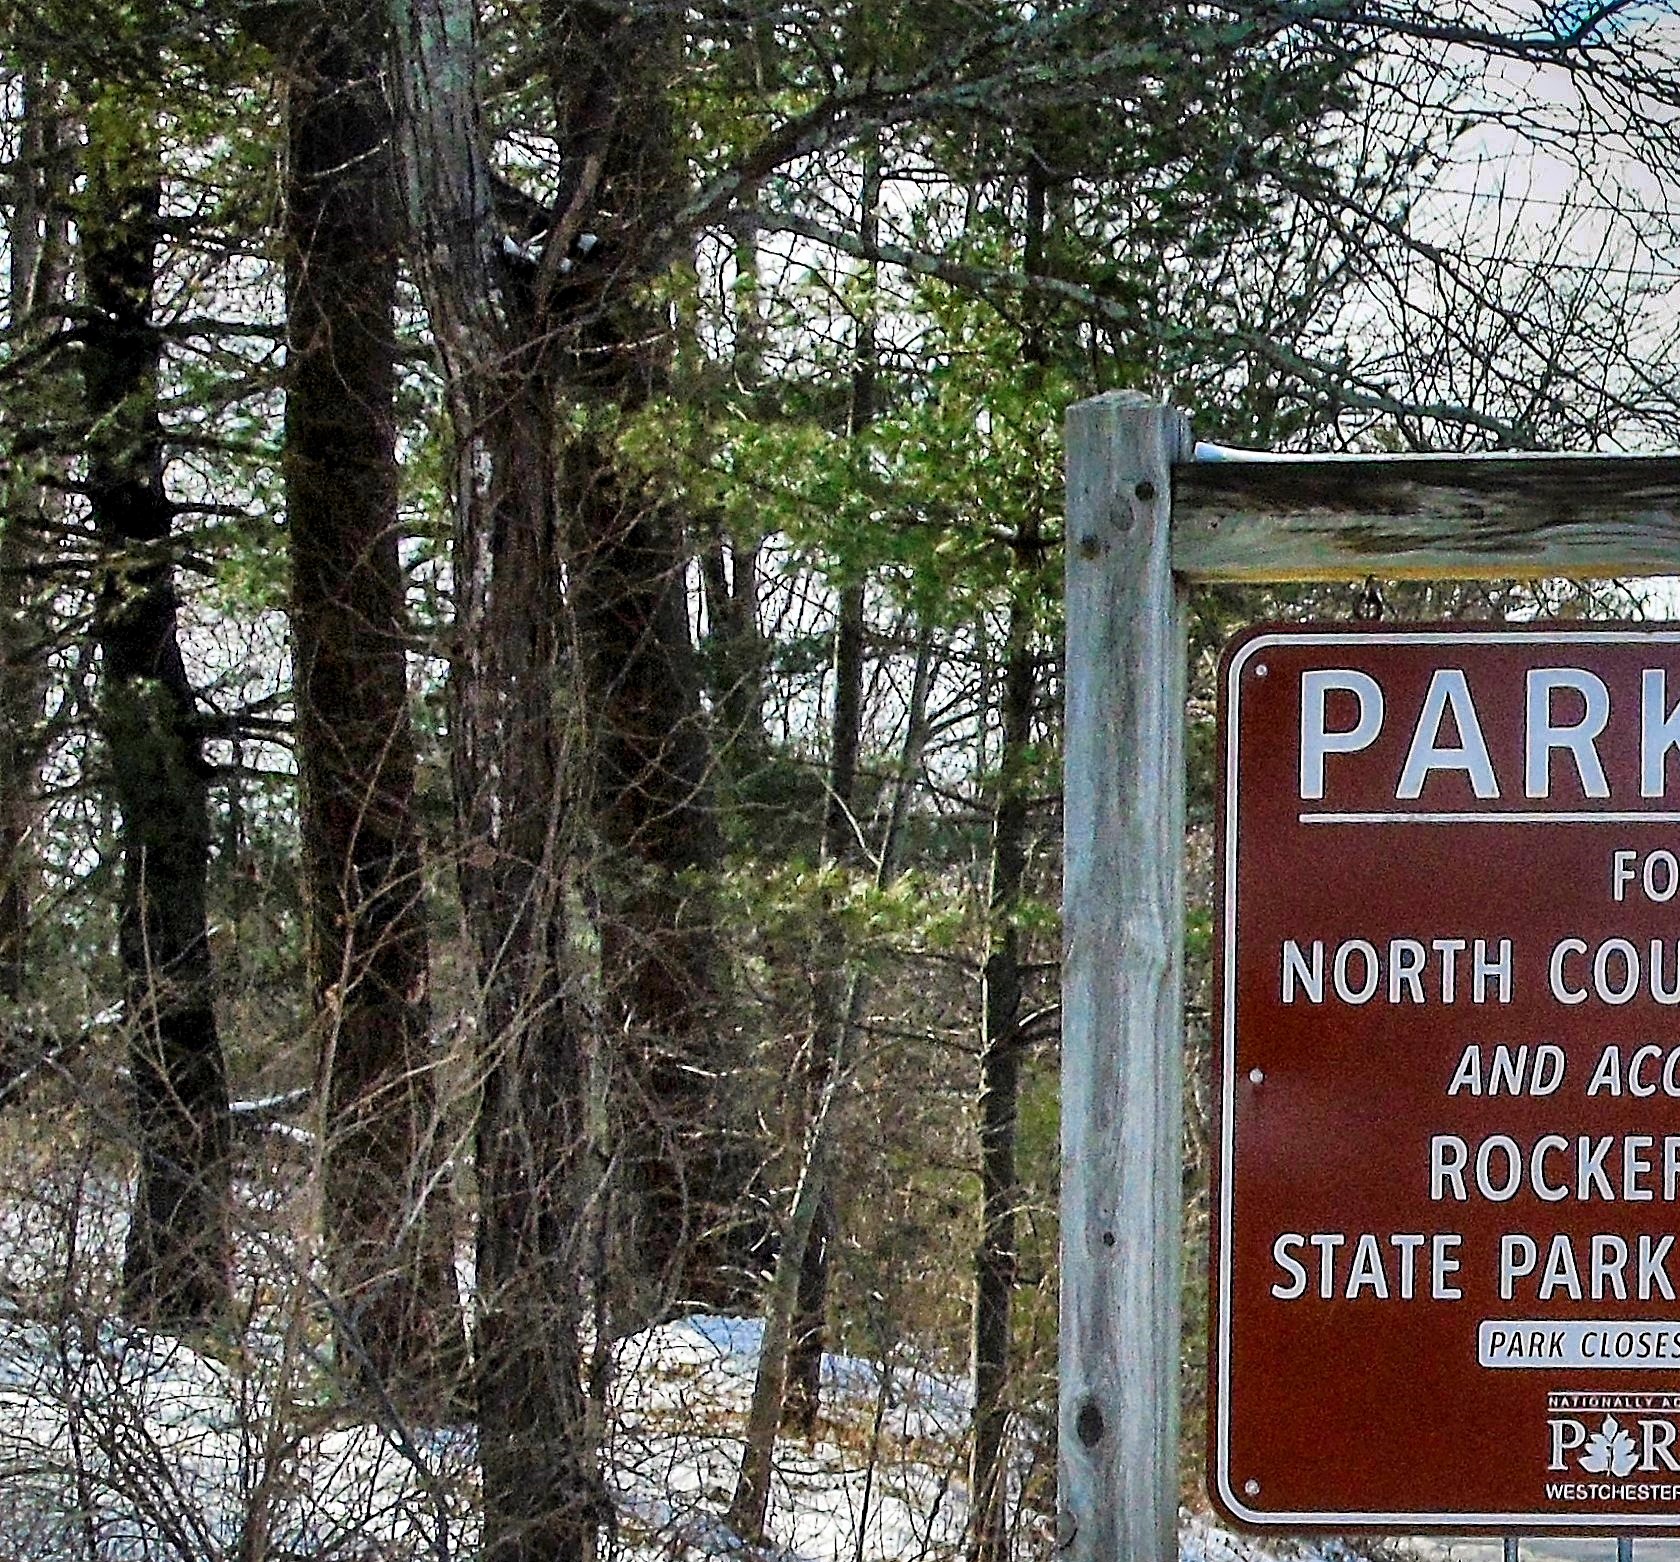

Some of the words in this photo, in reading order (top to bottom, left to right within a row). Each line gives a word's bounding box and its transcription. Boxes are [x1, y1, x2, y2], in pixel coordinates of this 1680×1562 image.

[1283, 940, 1511, 1004] NORTH
[1448, 1045, 1564, 1095] AND
[1272, 1234, 1461, 1299] STATE
[1501, 1235, 1675, 1299] PARK
[1490, 1332, 1565, 1357] PARK
[1548, 1396, 1652, 1408] NATIONALLY
